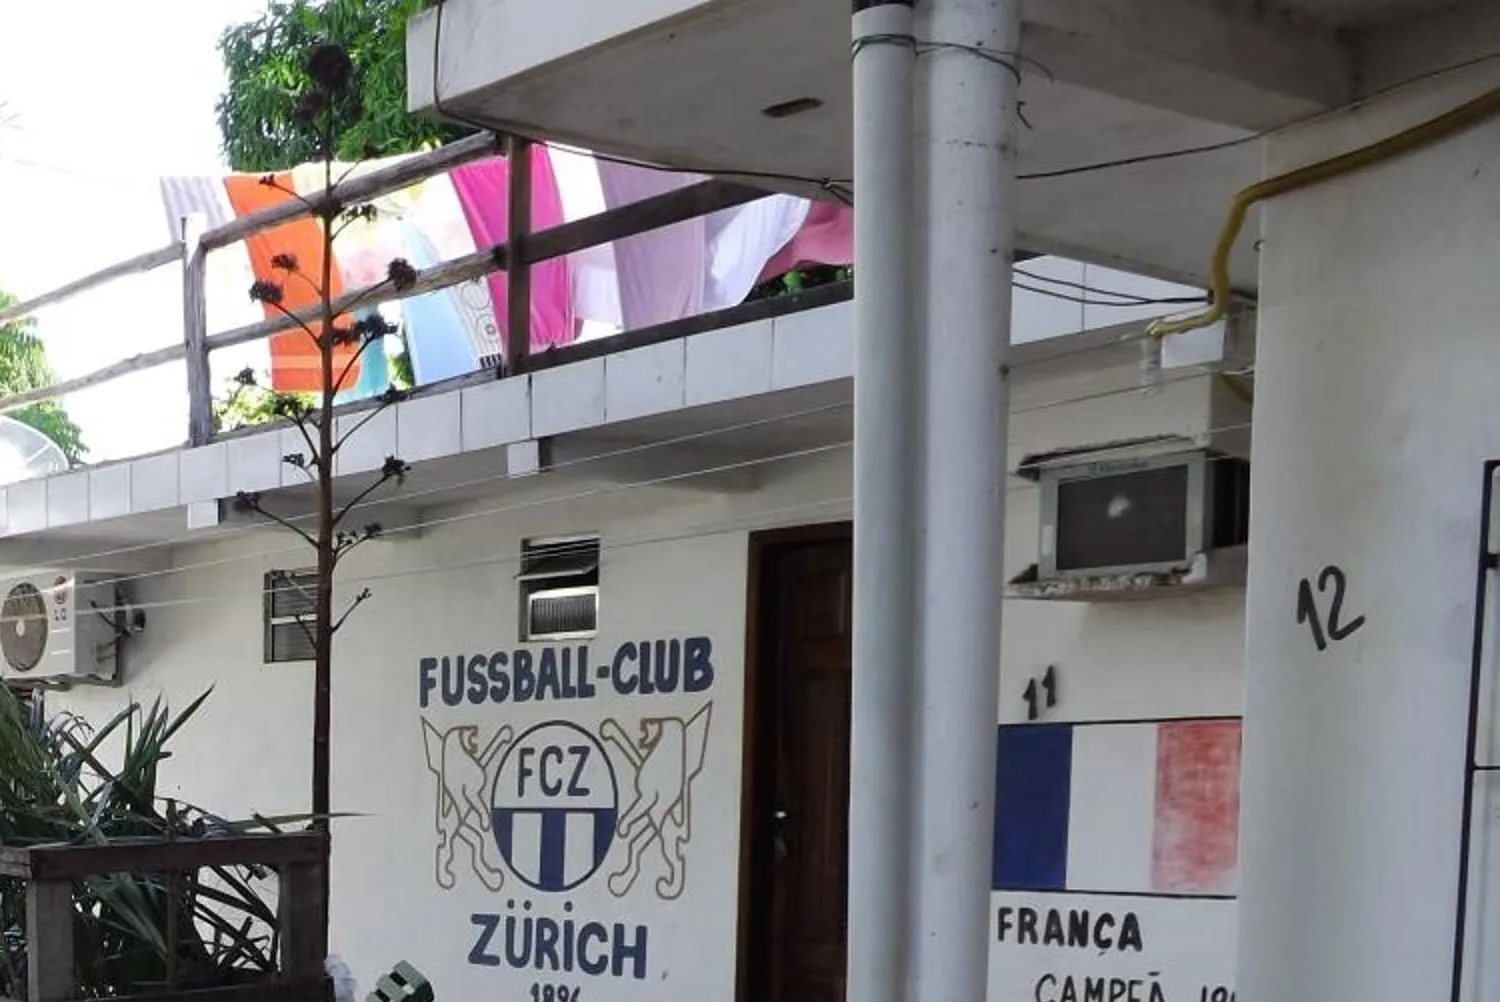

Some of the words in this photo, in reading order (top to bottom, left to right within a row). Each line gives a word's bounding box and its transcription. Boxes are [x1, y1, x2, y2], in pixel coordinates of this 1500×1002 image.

[1296, 564, 1366, 652] 12
[419, 637, 715, 708] FUSSBALL-CLUB
[1021, 664, 1057, 721] 11
[516, 744, 591, 798] FCZ
[467, 899, 648, 981] ZÜRICH
[997, 907, 1143, 956] FRANÇA
